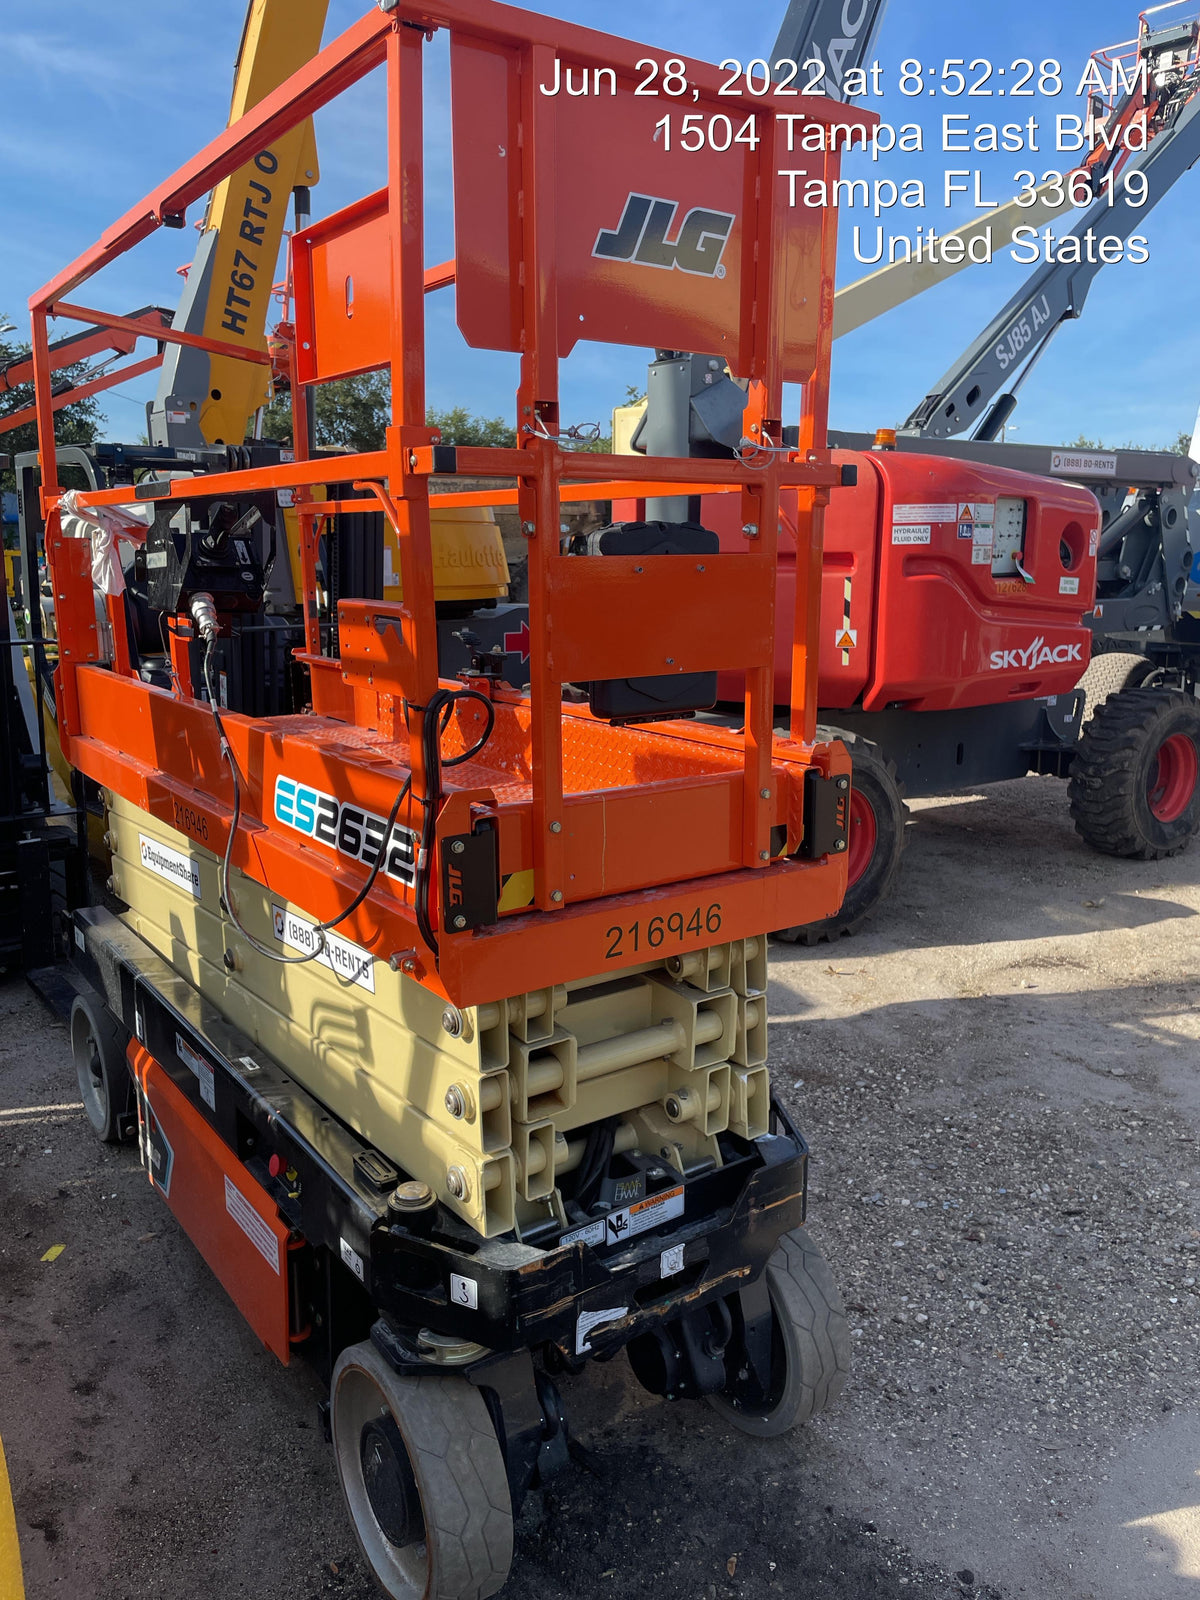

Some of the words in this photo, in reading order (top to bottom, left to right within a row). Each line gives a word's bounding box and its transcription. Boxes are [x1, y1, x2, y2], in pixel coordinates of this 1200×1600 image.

[239, 180, 272, 246] RTJ
[591, 191, 736, 279] JLG
[221, 249, 258, 336] HT67
[995, 317, 1032, 370] SJ85
[1031, 294, 1051, 332] AJ
[893, 527, 930, 535] HYDRAULIC
[893, 535, 911, 543] FLUID
[913, 535, 929, 543] ONLY
[989, 636, 1082, 671] SKYJACK
[174, 801, 209, 841] 216946
[275, 776, 415, 886] ES2632
[147, 845, 199, 887] EquipmentShare
[448, 863, 464, 906] JLG
[288, 919, 315, 951] (888)
[605, 903, 722, 959] 216946
